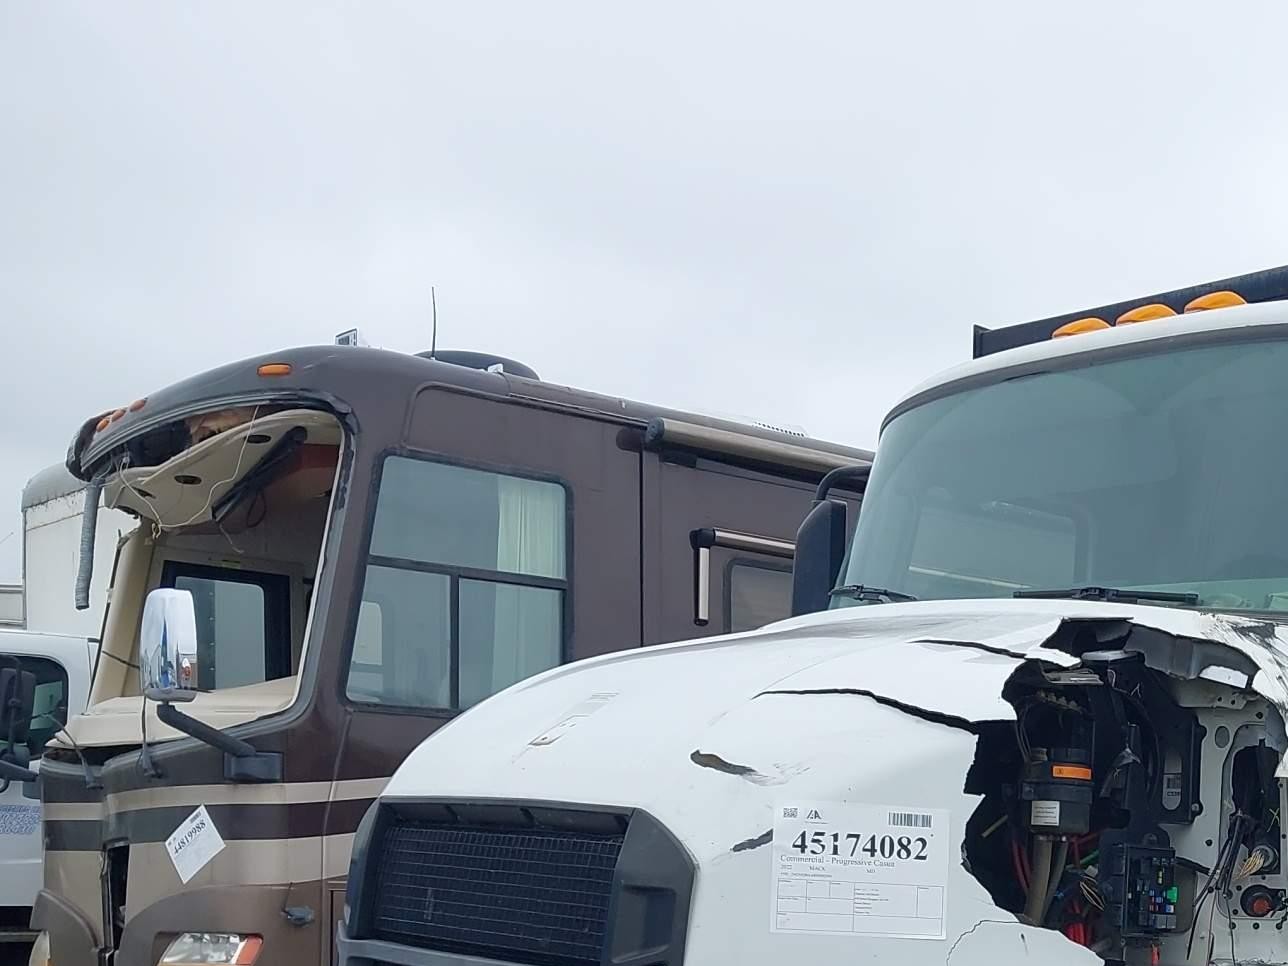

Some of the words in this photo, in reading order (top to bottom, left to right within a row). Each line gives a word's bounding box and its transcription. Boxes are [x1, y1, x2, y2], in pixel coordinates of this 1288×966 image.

[792, 830, 928, 860] 45174082
[780, 855, 825, 864] Commercial
[831, 857, 872, 867] Progressive
